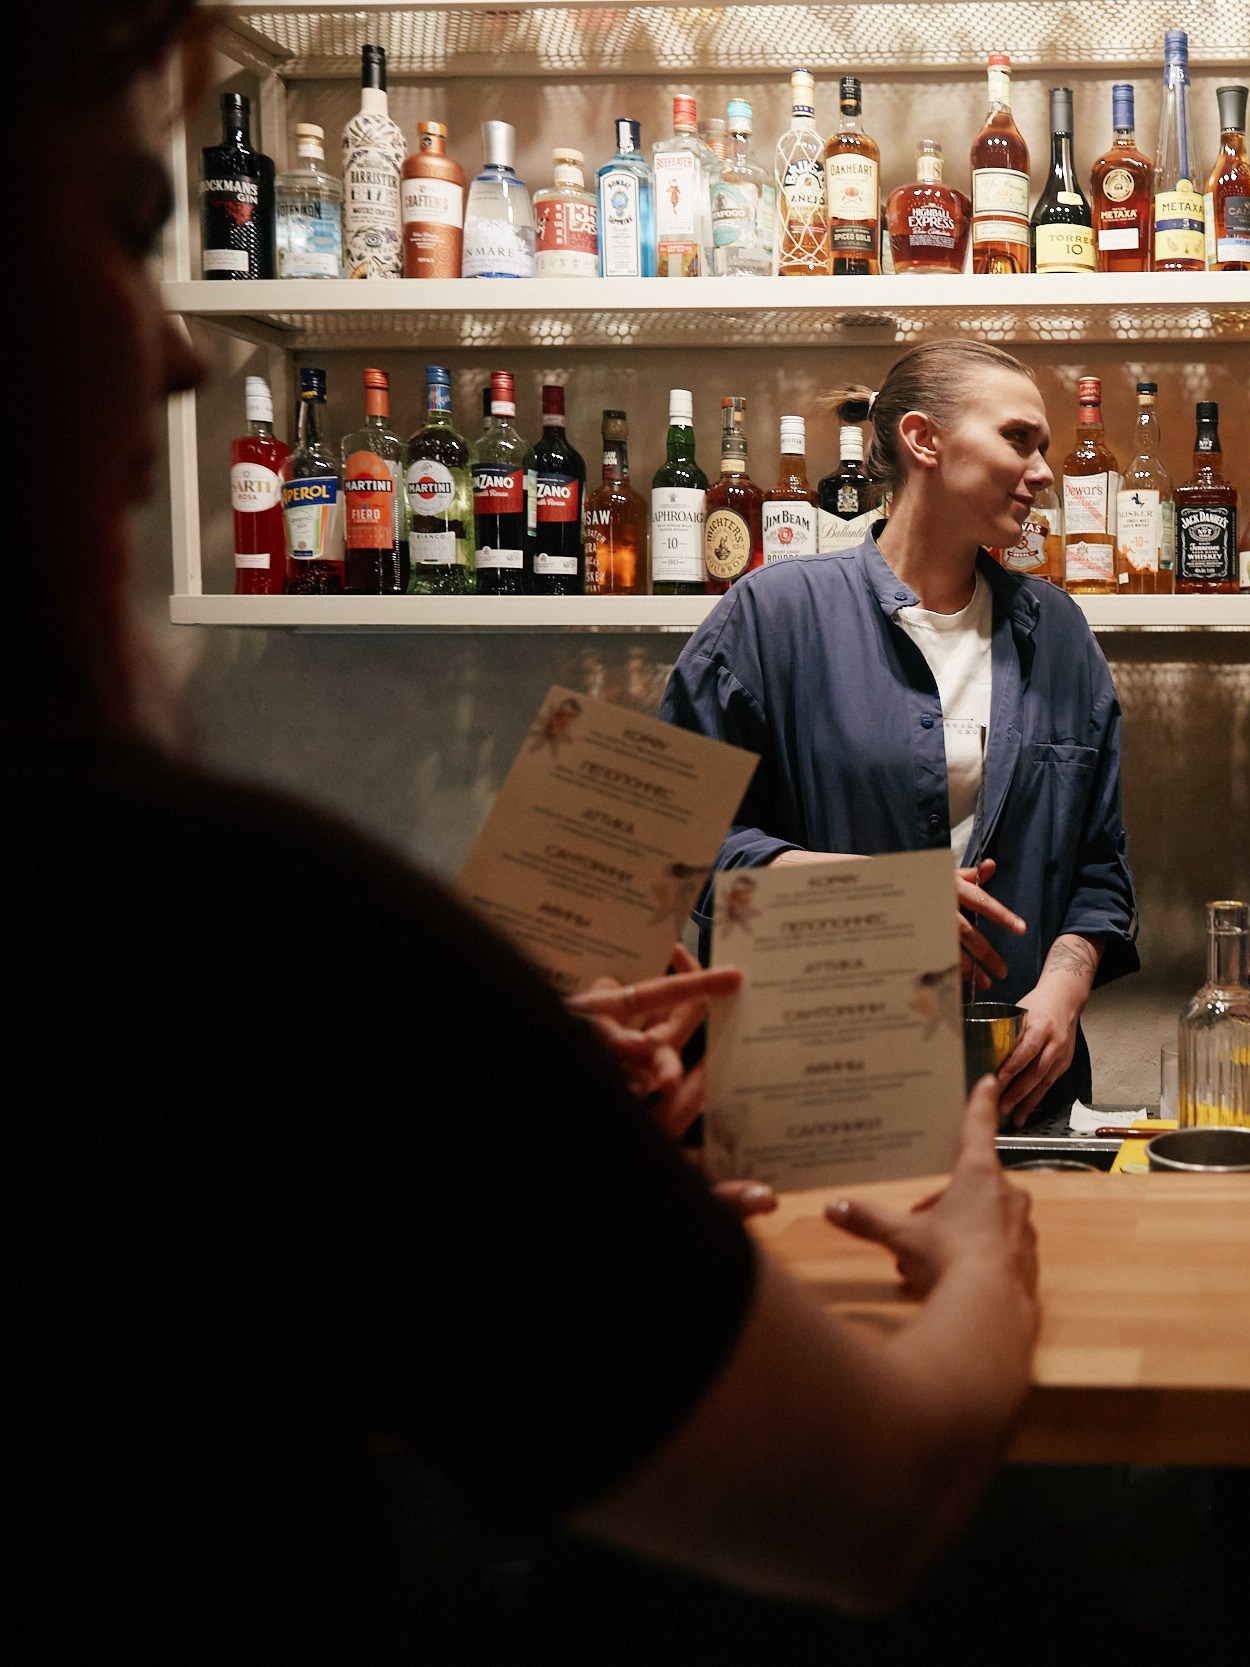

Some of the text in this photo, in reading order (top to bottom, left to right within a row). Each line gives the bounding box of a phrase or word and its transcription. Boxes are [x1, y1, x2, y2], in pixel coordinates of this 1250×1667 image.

[656, 157, 692, 169] BEEFEATER
[830, 164, 872, 177] OAKHEART
[351, 171, 397, 188] BARRISTER
[237, 193, 258, 205] GIN
[912, 207, 950, 219] HIGHBALL
[1162, 202, 1204, 214] METAXA
[1100, 209, 1137, 220] METAXA
[908, 215, 955, 230] EXPRESS
[833, 233, 872, 242] SPICED GOLD
[1050, 234, 1093, 245] TORRES
[1066, 243, 1083, 255] 10
[345, 481, 392, 491] MARTINI
[409, 483, 451, 493] MARTINI
[1065, 485, 1104, 495] Dewar's
[352, 509, 380, 520] FIERO
[586, 510, 610, 525] SAW
[1181, 511, 1229, 529] JACK DANIEL'S
[764, 510, 810, 532] JIM BEAM
[707, 517, 744, 543] MICHTER'S
[668, 537, 678, 549] 10
